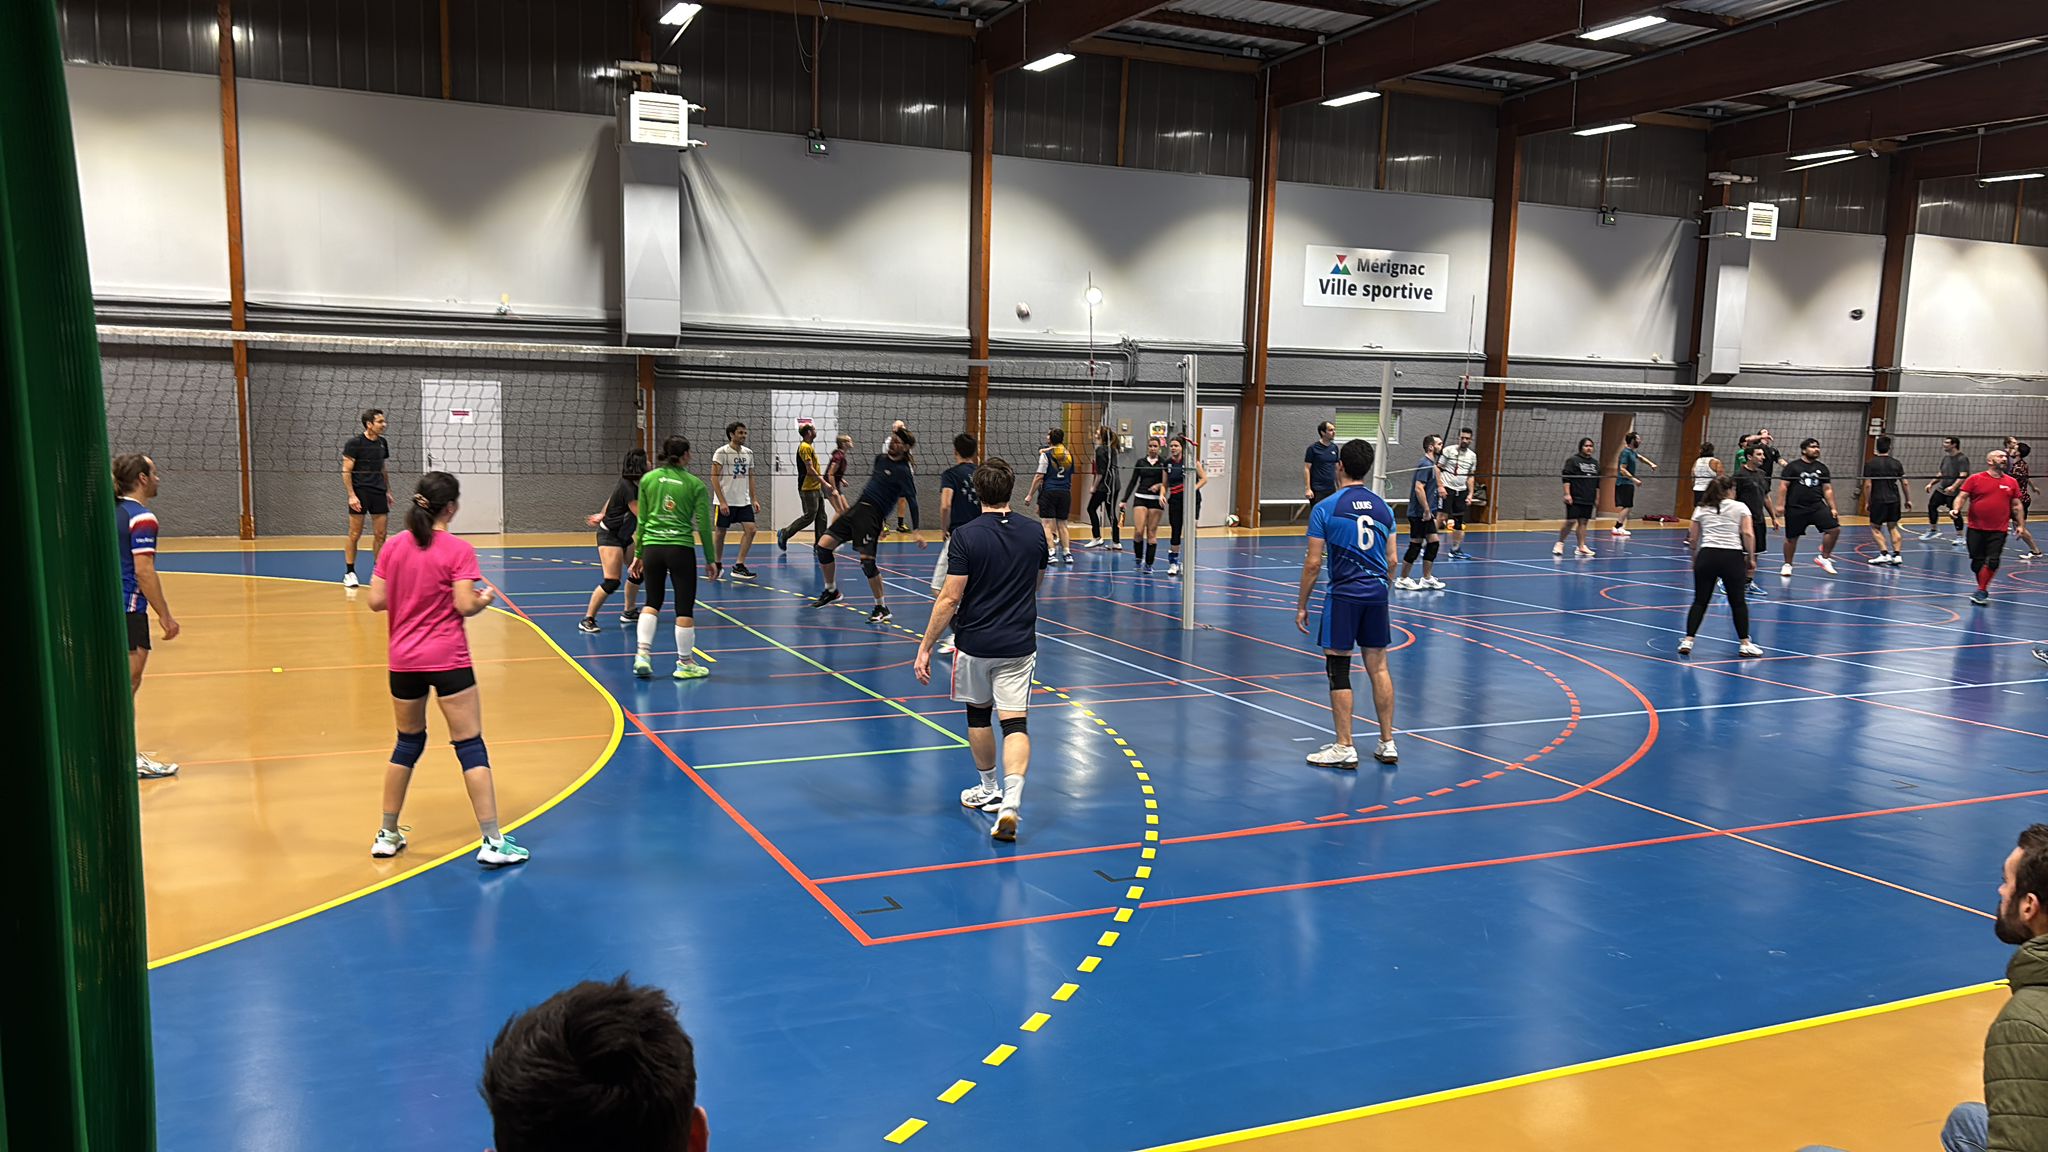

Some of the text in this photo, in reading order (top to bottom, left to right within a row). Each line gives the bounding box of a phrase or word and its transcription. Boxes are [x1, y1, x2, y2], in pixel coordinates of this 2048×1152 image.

[1357, 258, 1425, 278] Mérignac
[1319, 278, 1433, 302] Ville sportive
[733, 464, 747, 475] 33
[1057, 466, 1065, 478] 2
[1352, 500, 1373, 510] LOUIS
[1357, 515, 1375, 551] 6
